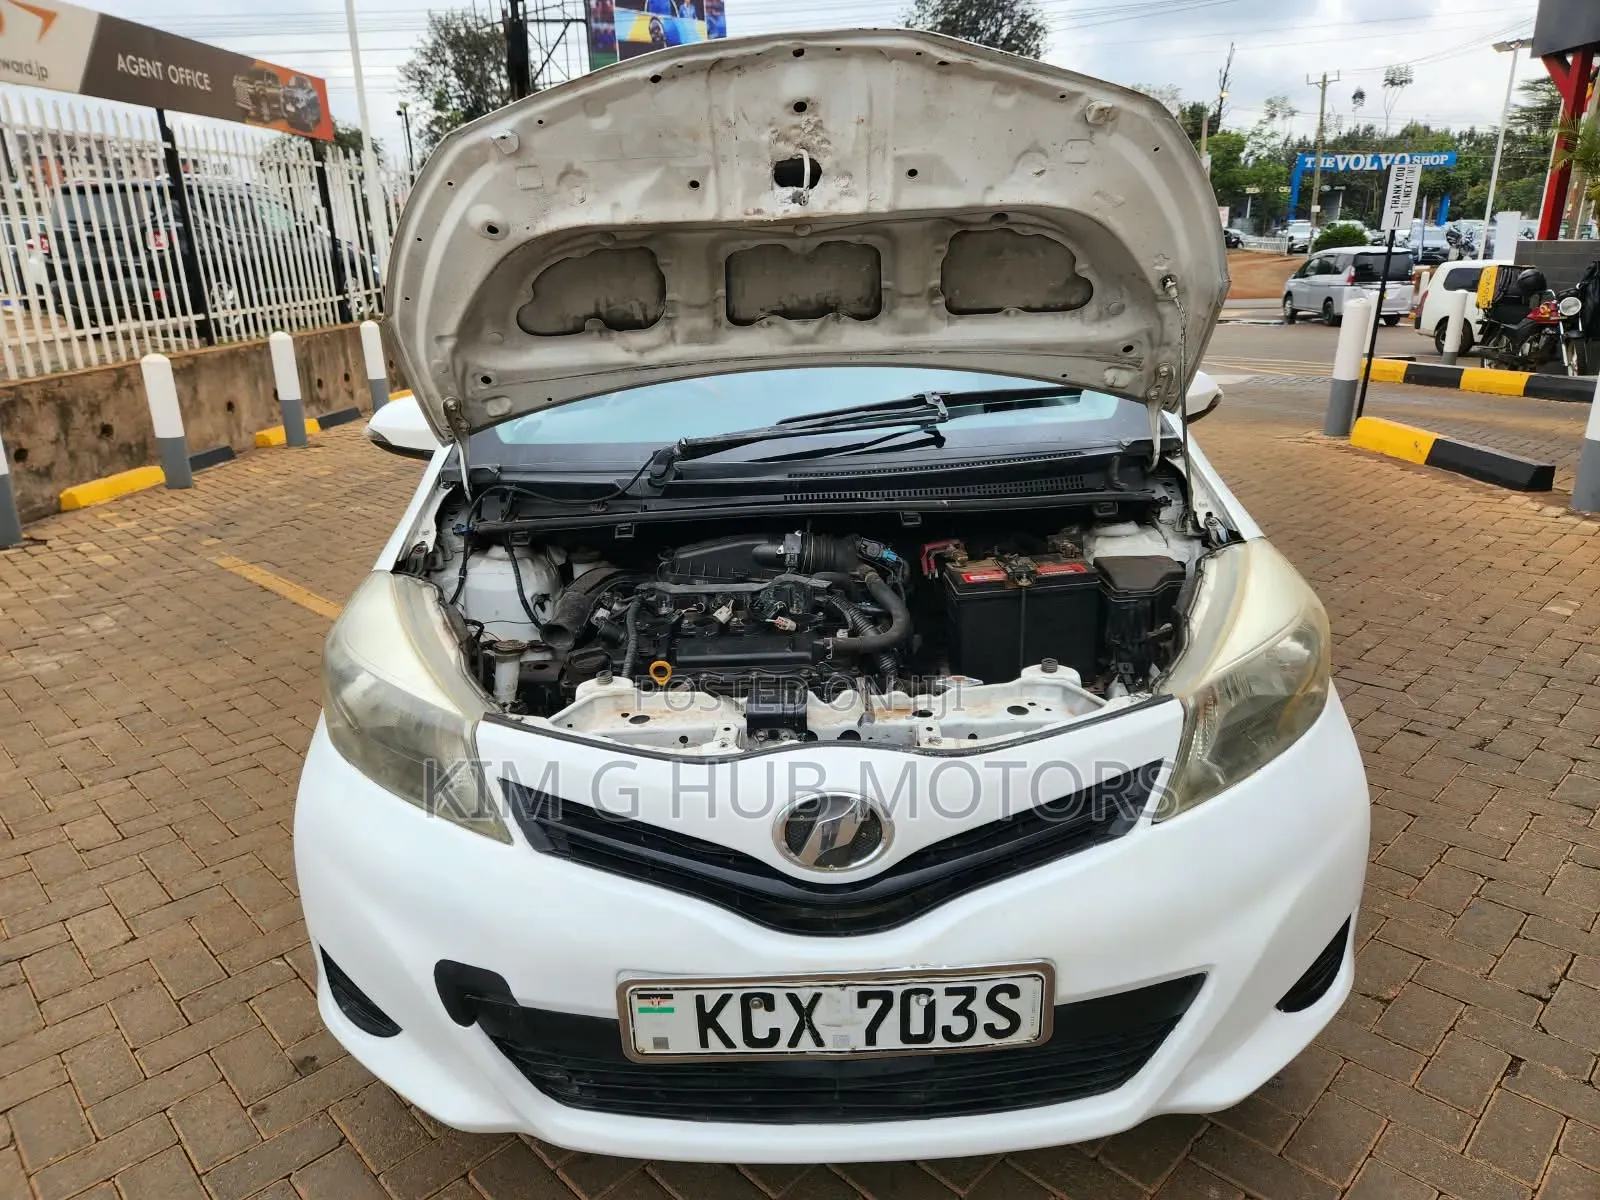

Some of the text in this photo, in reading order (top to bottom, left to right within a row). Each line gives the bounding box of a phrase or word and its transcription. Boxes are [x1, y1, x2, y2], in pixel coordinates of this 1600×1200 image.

[117, 52, 212, 91] AGENT OFFICE
[1335, 154, 1411, 171] VOLVO
[1412, 154, 1449, 165] SHOP
[1391, 167, 1406, 209] THANK YOU
[1403, 181, 1414, 198] NEXT
[695, 991, 825, 1049] KCX
[857, 983, 1022, 1046] 703S
